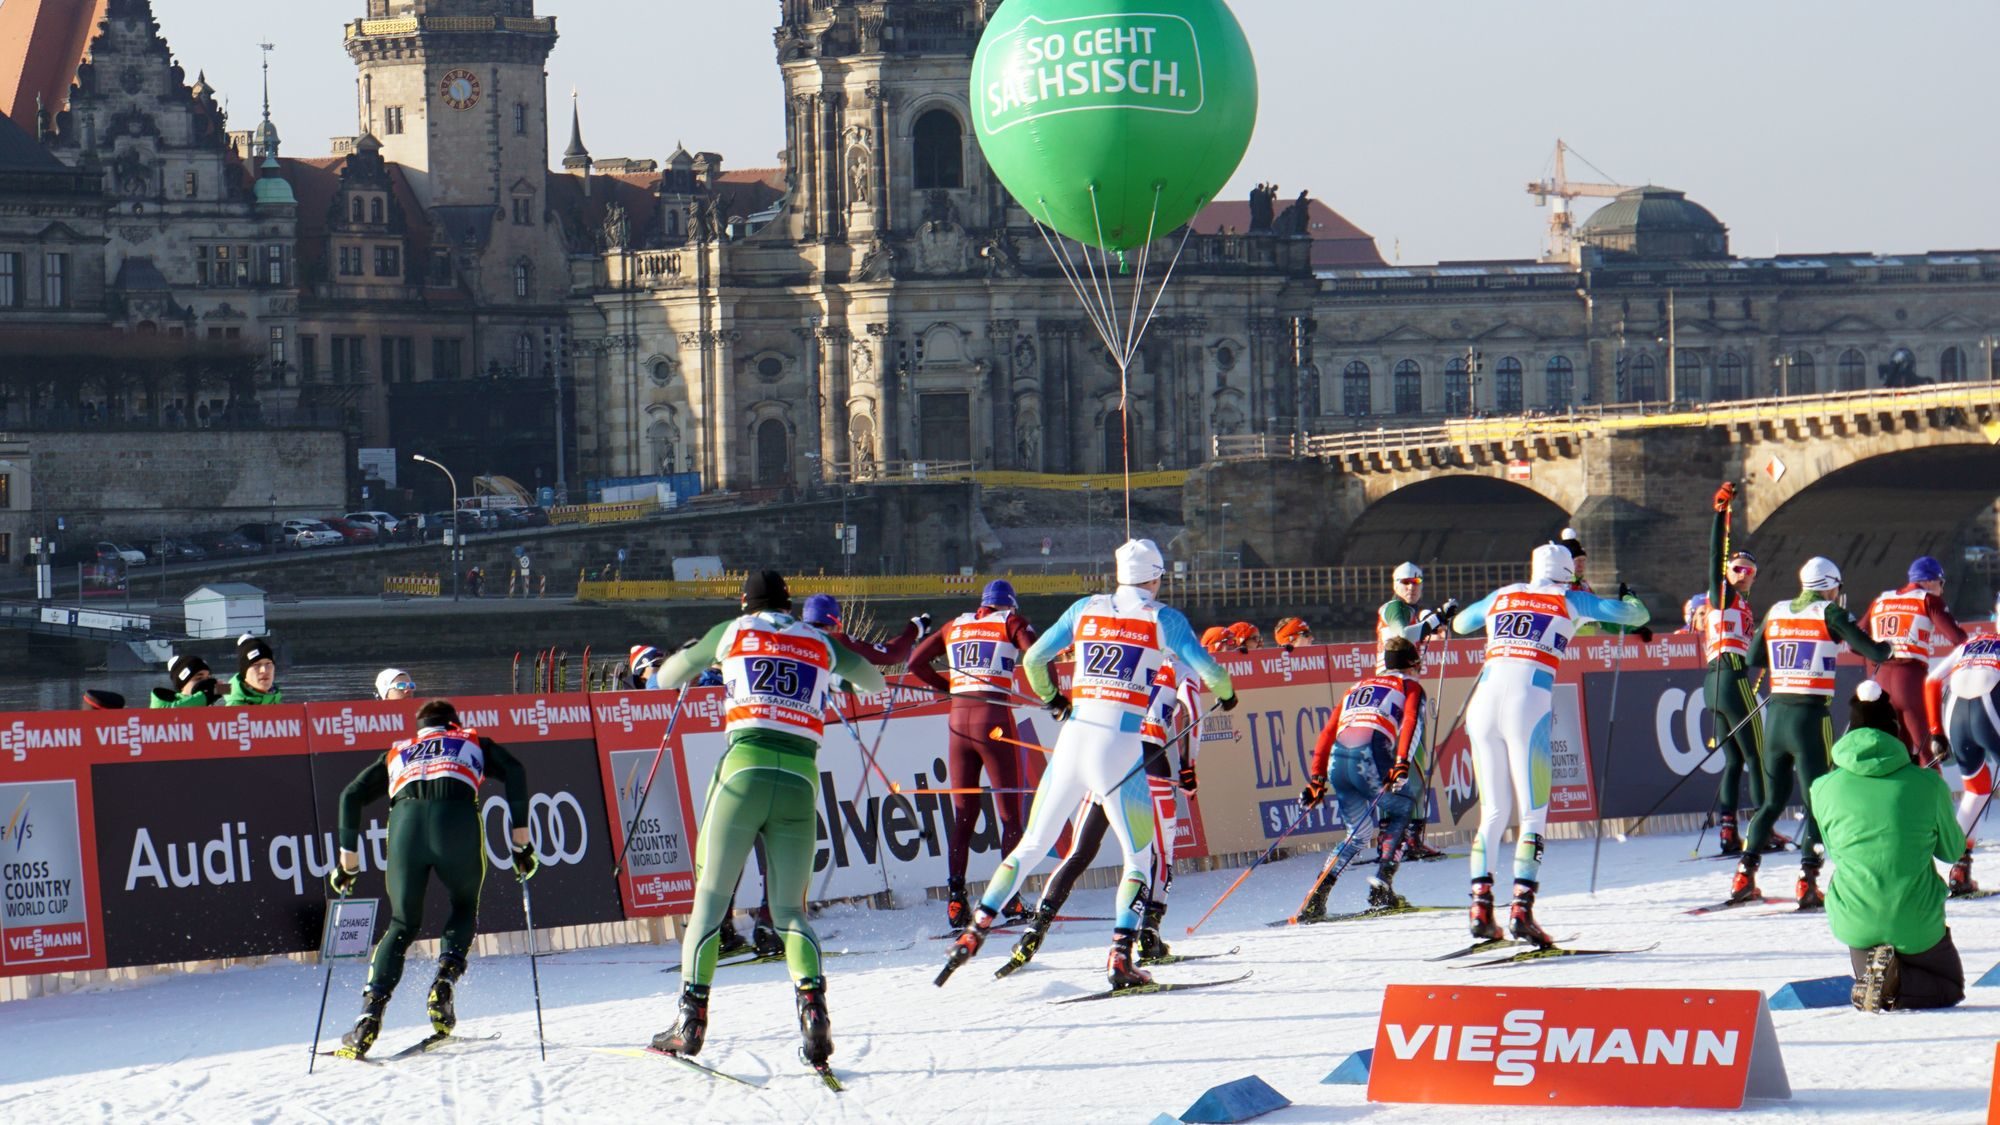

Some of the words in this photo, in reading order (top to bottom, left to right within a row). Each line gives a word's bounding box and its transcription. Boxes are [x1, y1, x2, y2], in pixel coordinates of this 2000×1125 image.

[1027, 34, 1065, 65] SO
[1073, 27, 1156, 57] GEHT
[1510, 598, 1559, 612] Sparkasse
[1884, 603, 1919, 612] Sparkasse
[962, 629, 1000, 638] Sparkasse
[1099, 627, 1150, 642] Sparkasse
[1494, 612, 1534, 639] 26
[1531, 629, 1540, 641] 2
[1779, 627, 1819, 637] Sparkasse
[1879, 615, 1899, 637] 19
[764, 640, 821, 661] Sparkasse
[957, 642, 980, 667] 14
[1085, 643, 1123, 678] 22
[1122, 667, 1132, 681] 2
[1645, 638, 1697, 666] VIESSMANN
[1777, 642, 1799, 669] 17
[1261, 650, 1326, 682] VIESSMANN
[752, 659, 799, 697] 25
[801, 687, 811, 702] 2
[1350, 687, 1375, 708] 16
[510, 699, 591, 735] VIESSMANN
[597, 697, 672, 732] VIESSMANN
[749, 704, 809, 724] VIESSMANN
[96, 716, 194, 756] VIESSMANN
[207, 712, 301, 751] VIESSMANN
[312, 708, 404, 745] VIESSMANN
[406, 739, 445, 763] 24
[1247, 710, 1292, 790] LE
[1552, 787, 1587, 807] VIESSMANN
[627, 818, 661, 834] CROSS
[630, 834, 678, 853] COUNTRY
[125, 822, 251, 891] Audi
[269, 819, 388, 895] qut
[631, 853, 661, 867] WORLD
[662, 851, 678, 864] CUP
[4, 861, 49, 880] CROSS
[5, 879, 71, 900] COUNTRY
[637, 876, 692, 901] VIESSMANN
[6, 901, 45, 918] WORLD
[48, 899, 69, 914] CUP
[10, 928, 82, 957] VIESSMANN
[340, 931, 359, 940] ZONE
[1385, 1009, 1739, 1086] VIESSMANN
